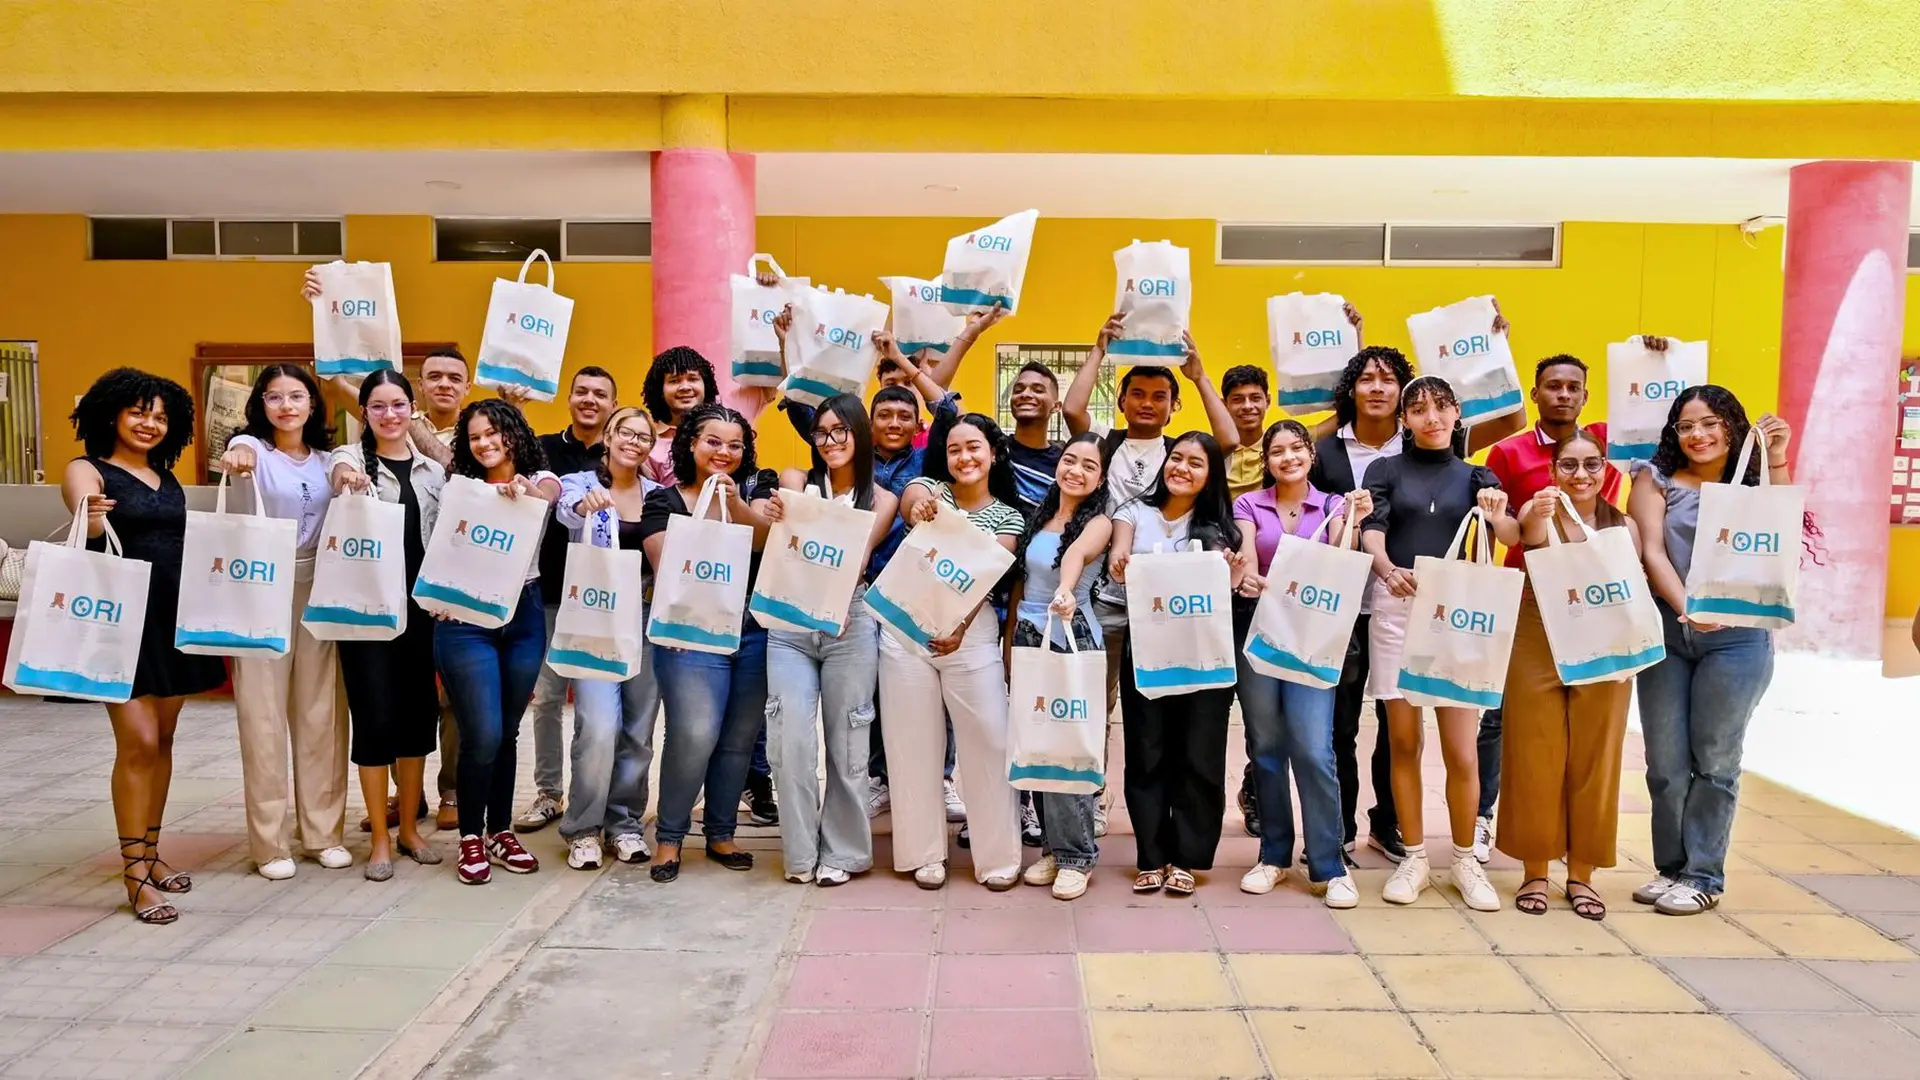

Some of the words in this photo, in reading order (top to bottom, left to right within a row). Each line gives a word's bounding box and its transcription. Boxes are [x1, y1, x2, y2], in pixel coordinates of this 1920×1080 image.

[978, 235, 1010, 251] ORI
[922, 286, 941, 302] OR
[1139, 279, 1175, 295] ORI
[343, 300, 376, 316] ORI
[521, 315, 554, 338] ORI
[830, 328, 862, 349] ORI
[1306, 331, 1341, 346] ORI
[1454, 335, 1489, 355] ORI
[1645, 381, 1688, 398] ORI
[343, 538, 381, 559] ORI
[471, 525, 514, 551] ORI
[1732, 532, 1778, 552] ORI
[803, 541, 844, 568] ORI
[230, 558, 275, 582] ORI
[696, 560, 731, 582] ORI
[937, 559, 975, 593] ORI
[583, 588, 616, 609] ORI
[1301, 585, 1340, 612] ORI
[1585, 580, 1631, 605] ORI
[71, 596, 121, 623] ORI
[1170, 595, 1211, 615] ORI
[1451, 609, 1494, 633] ORI
[1051, 698, 1086, 718] ORI
